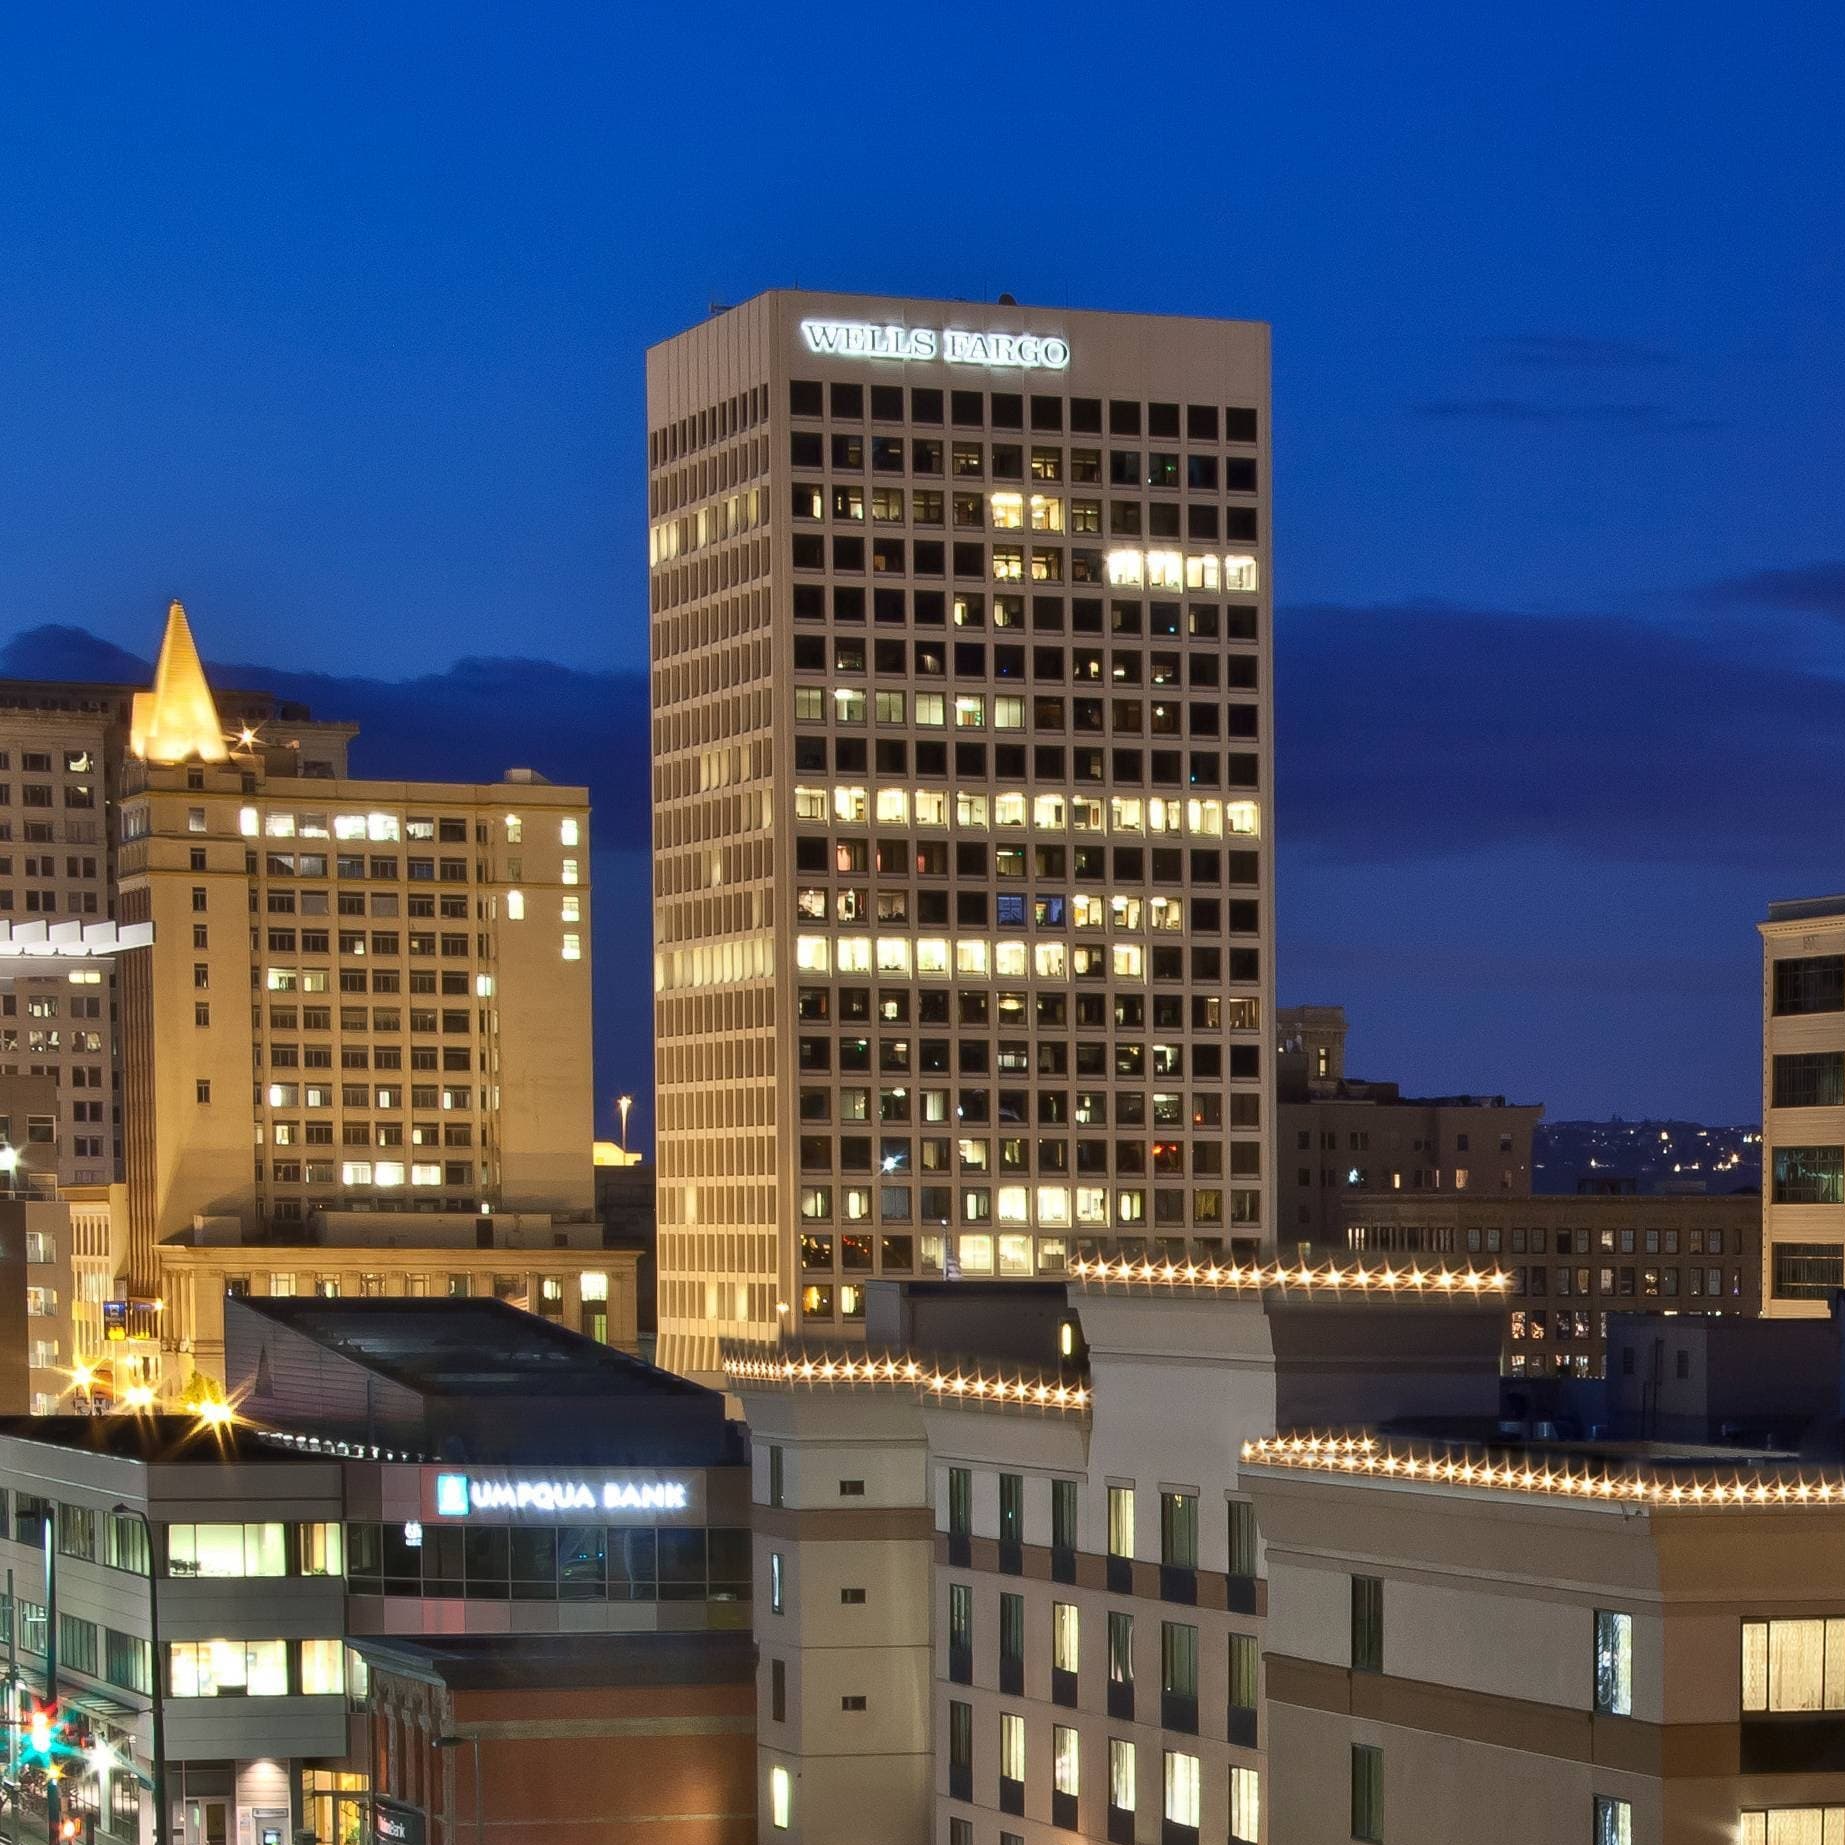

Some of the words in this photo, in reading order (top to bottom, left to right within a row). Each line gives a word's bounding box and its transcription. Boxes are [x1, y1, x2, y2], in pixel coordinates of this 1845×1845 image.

[802, 322, 936, 360] WELLS
[943, 329, 1070, 368] FARGO
[471, 1480, 596, 1510] UMPQUA
[604, 1481, 689, 1509] BANK
